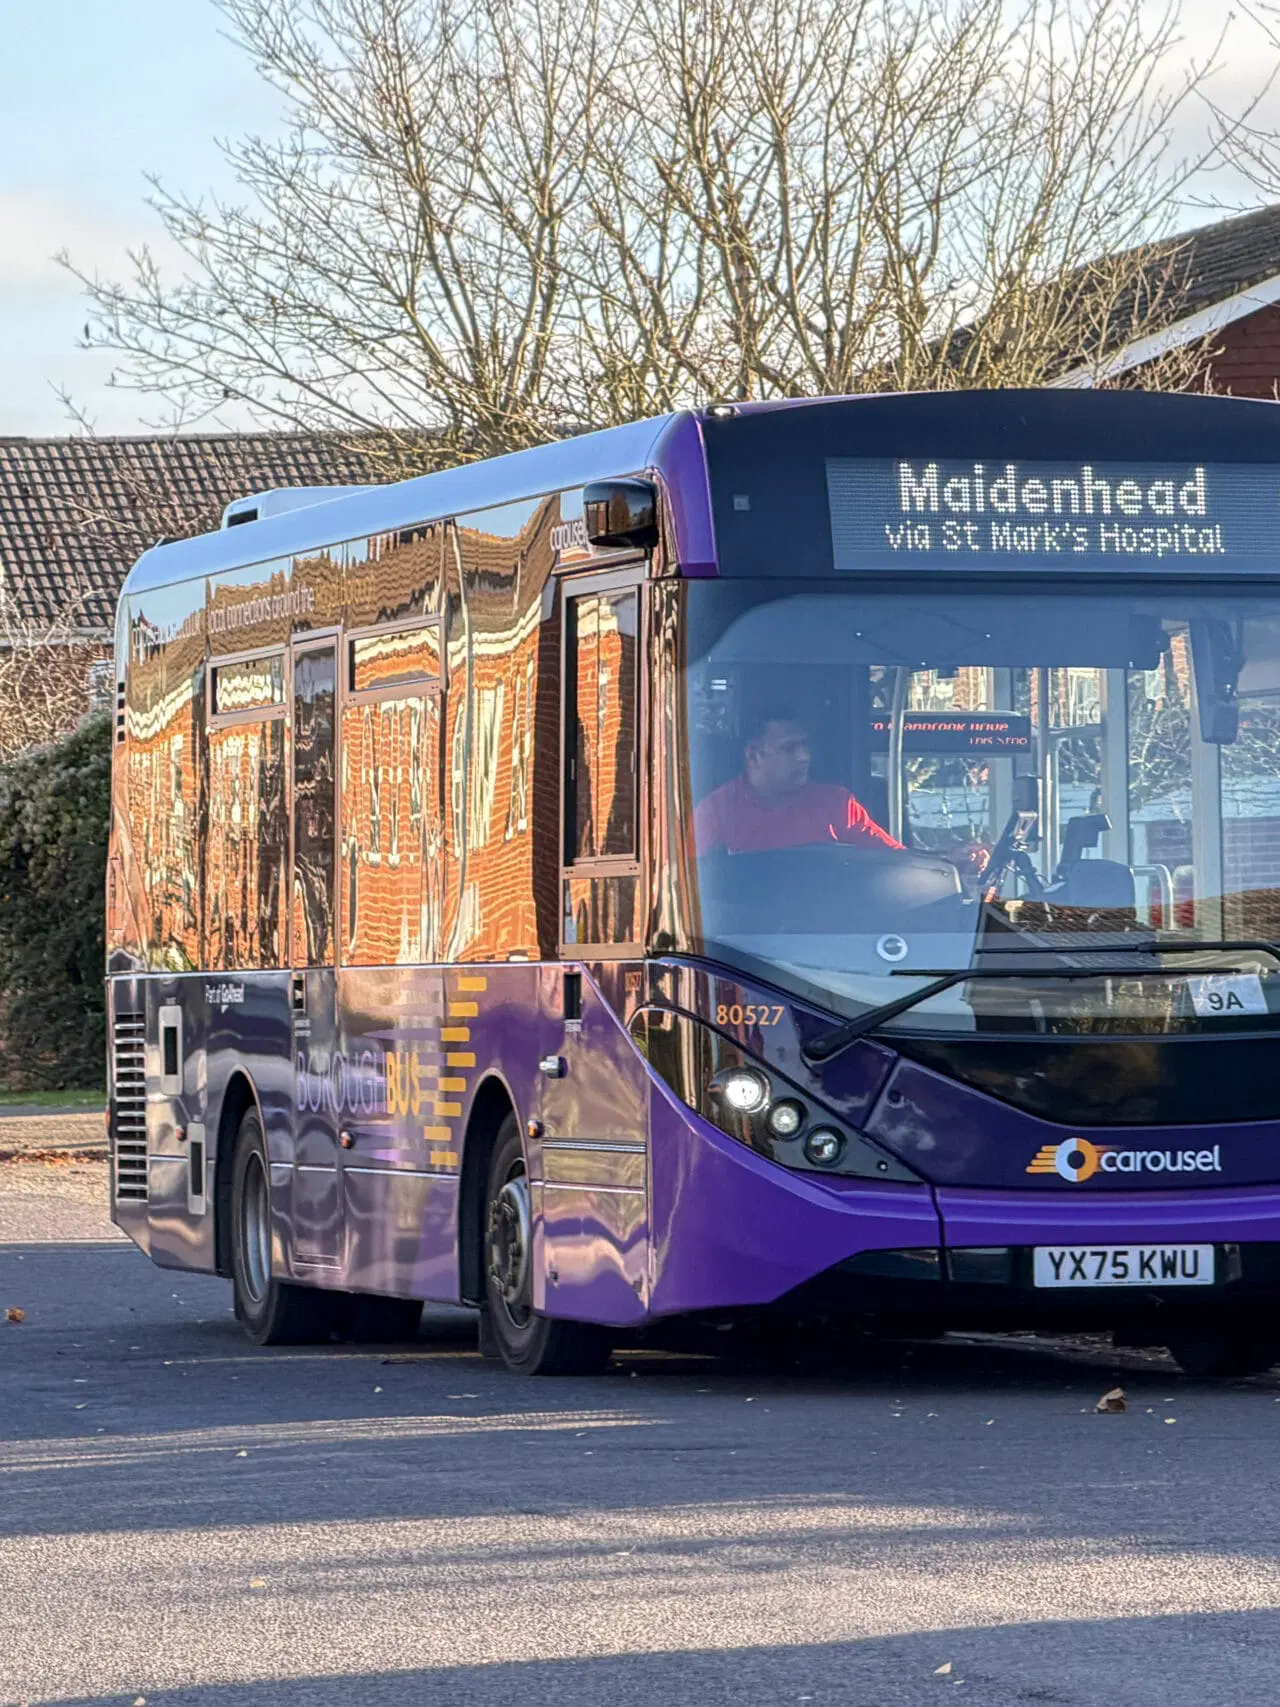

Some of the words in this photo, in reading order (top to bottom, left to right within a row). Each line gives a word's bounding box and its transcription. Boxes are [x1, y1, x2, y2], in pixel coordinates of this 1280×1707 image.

[897, 460, 1208, 516] Maidenhead
[885, 518, 931, 550] via
[942, 519, 979, 551] St
[990, 520, 1090, 553] Mark's
[1099, 521, 1226, 557] Hospital
[715, 1003, 785, 1027] 80527
[1206, 989, 1244, 1012] 9A
[1099, 1145, 1222, 1174] carousel
[1047, 1249, 1130, 1281] YX75
[1137, 1249, 1200, 1280] KWU
